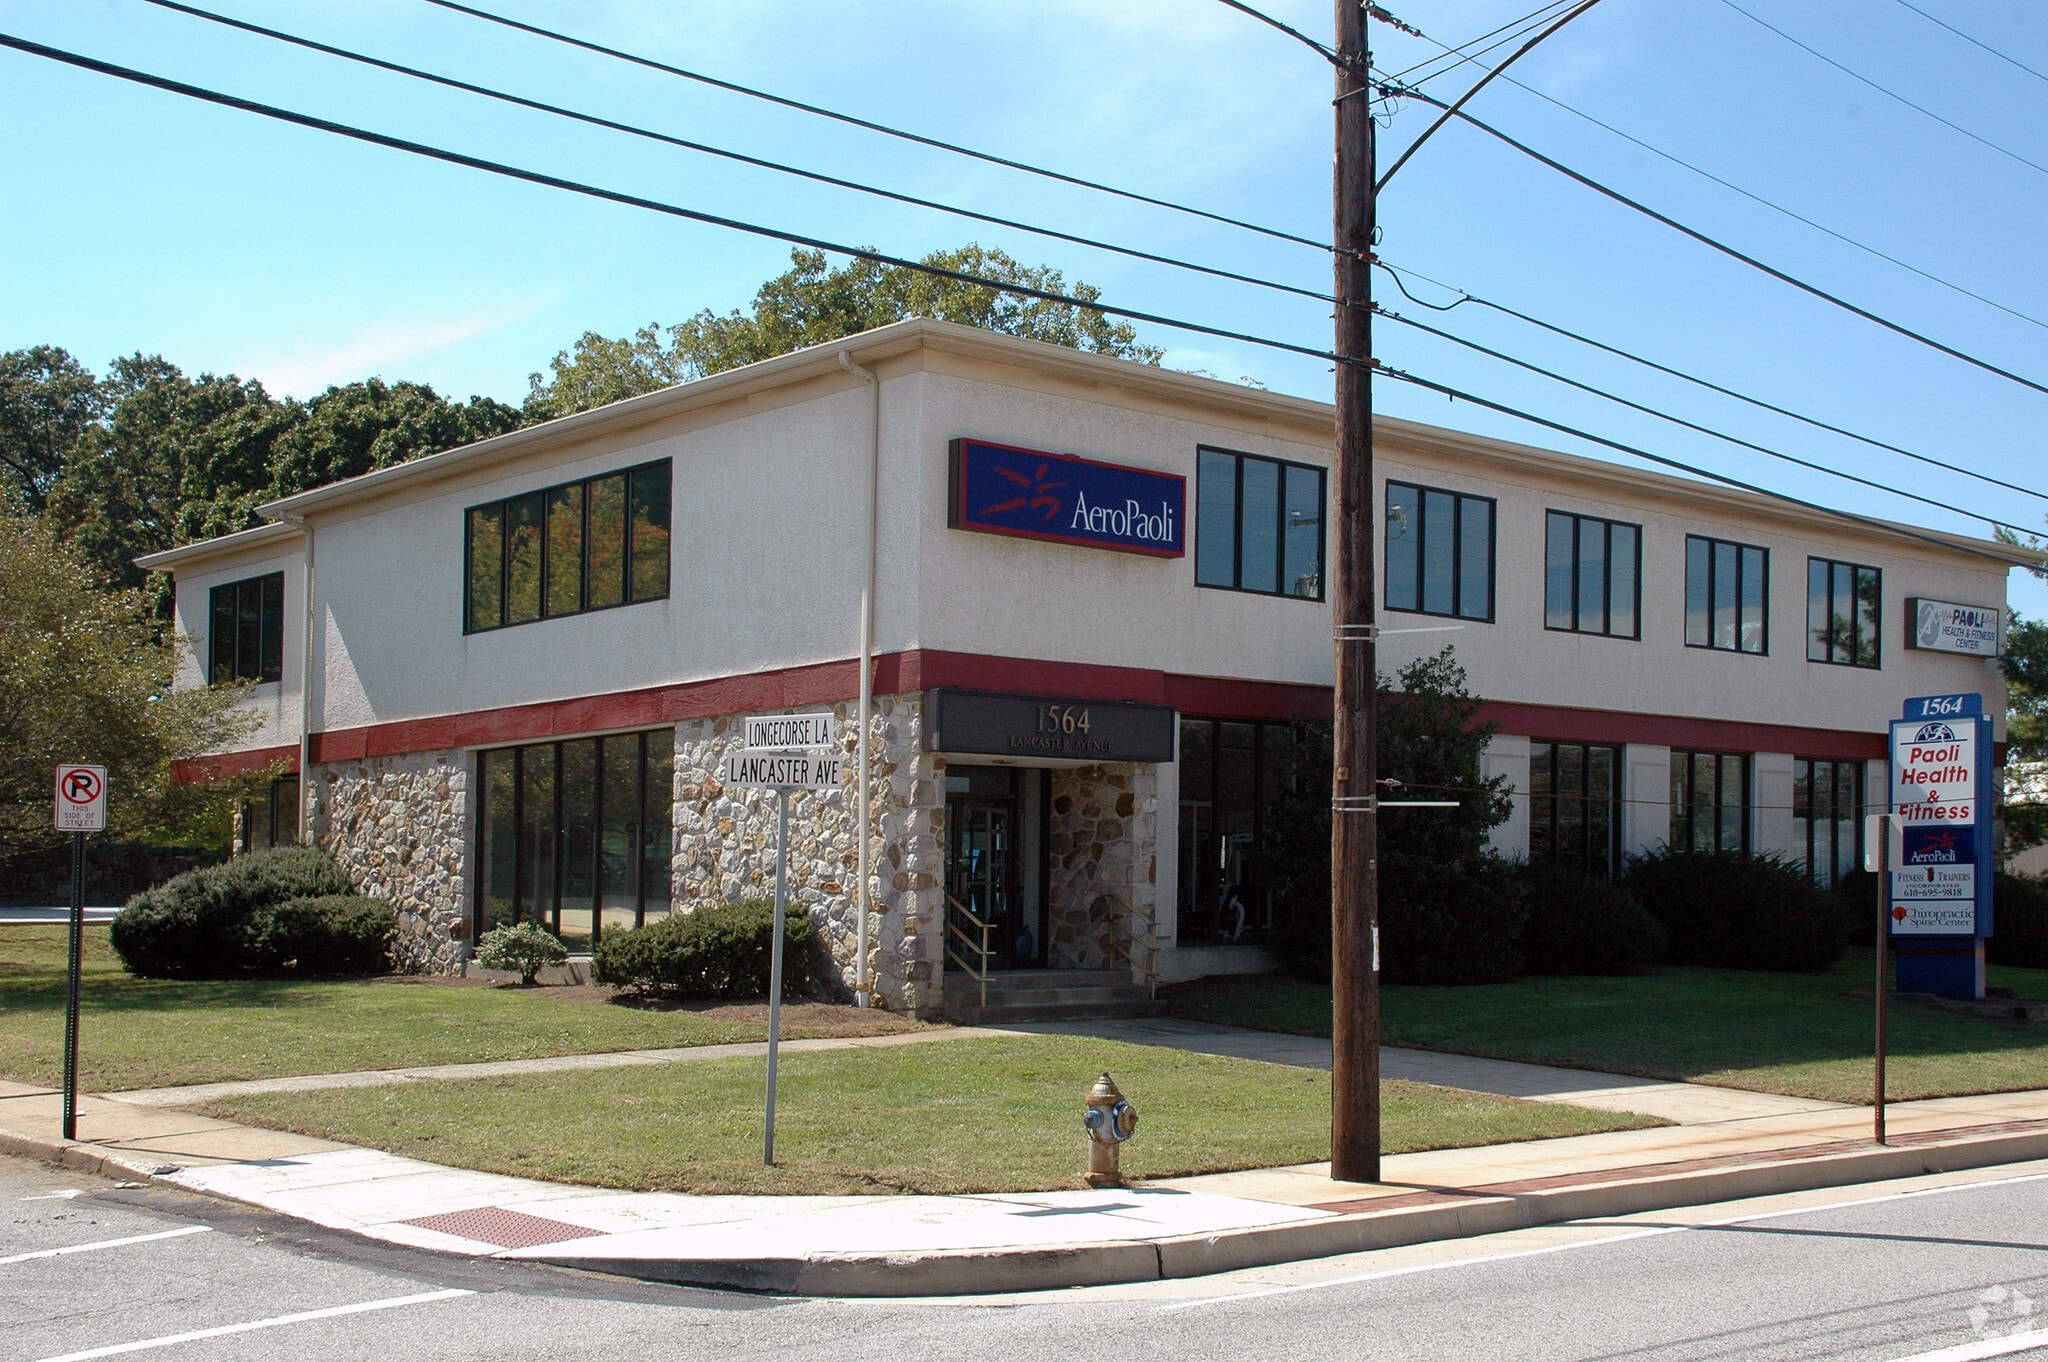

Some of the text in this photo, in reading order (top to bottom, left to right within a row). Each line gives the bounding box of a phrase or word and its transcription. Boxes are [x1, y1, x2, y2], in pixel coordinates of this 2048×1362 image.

[1070, 490, 1174, 542] AeroPaoli
[1952, 608, 1984, 628] PAOLI
[1942, 625, 1995, 641] HEALTH & FITNESS
[1955, 638, 1979, 649] CENTER
[1920, 696, 1963, 716] 1564
[1037, 704, 1091, 735] 1564
[749, 719, 829, 747] LONGECORSE LA
[1010, 736, 1112, 752] LANCASTER AVENUE
[1910, 744, 1960, 764] Paoli
[731, 757, 839, 784] LANCASTER AVE
[1901, 765, 1968, 785] Health
[1927, 789, 1940, 804] &
[1899, 803, 1970, 820] Fitness
[65, 819, 95, 827] STREET
[1911, 849, 1956, 863] AeroPaoli
[1904, 888, 1962, 897] 610-695-9818
[1906, 907, 1975, 921] Chiropractic
[1910, 918, 1970, 928] Spine Center
